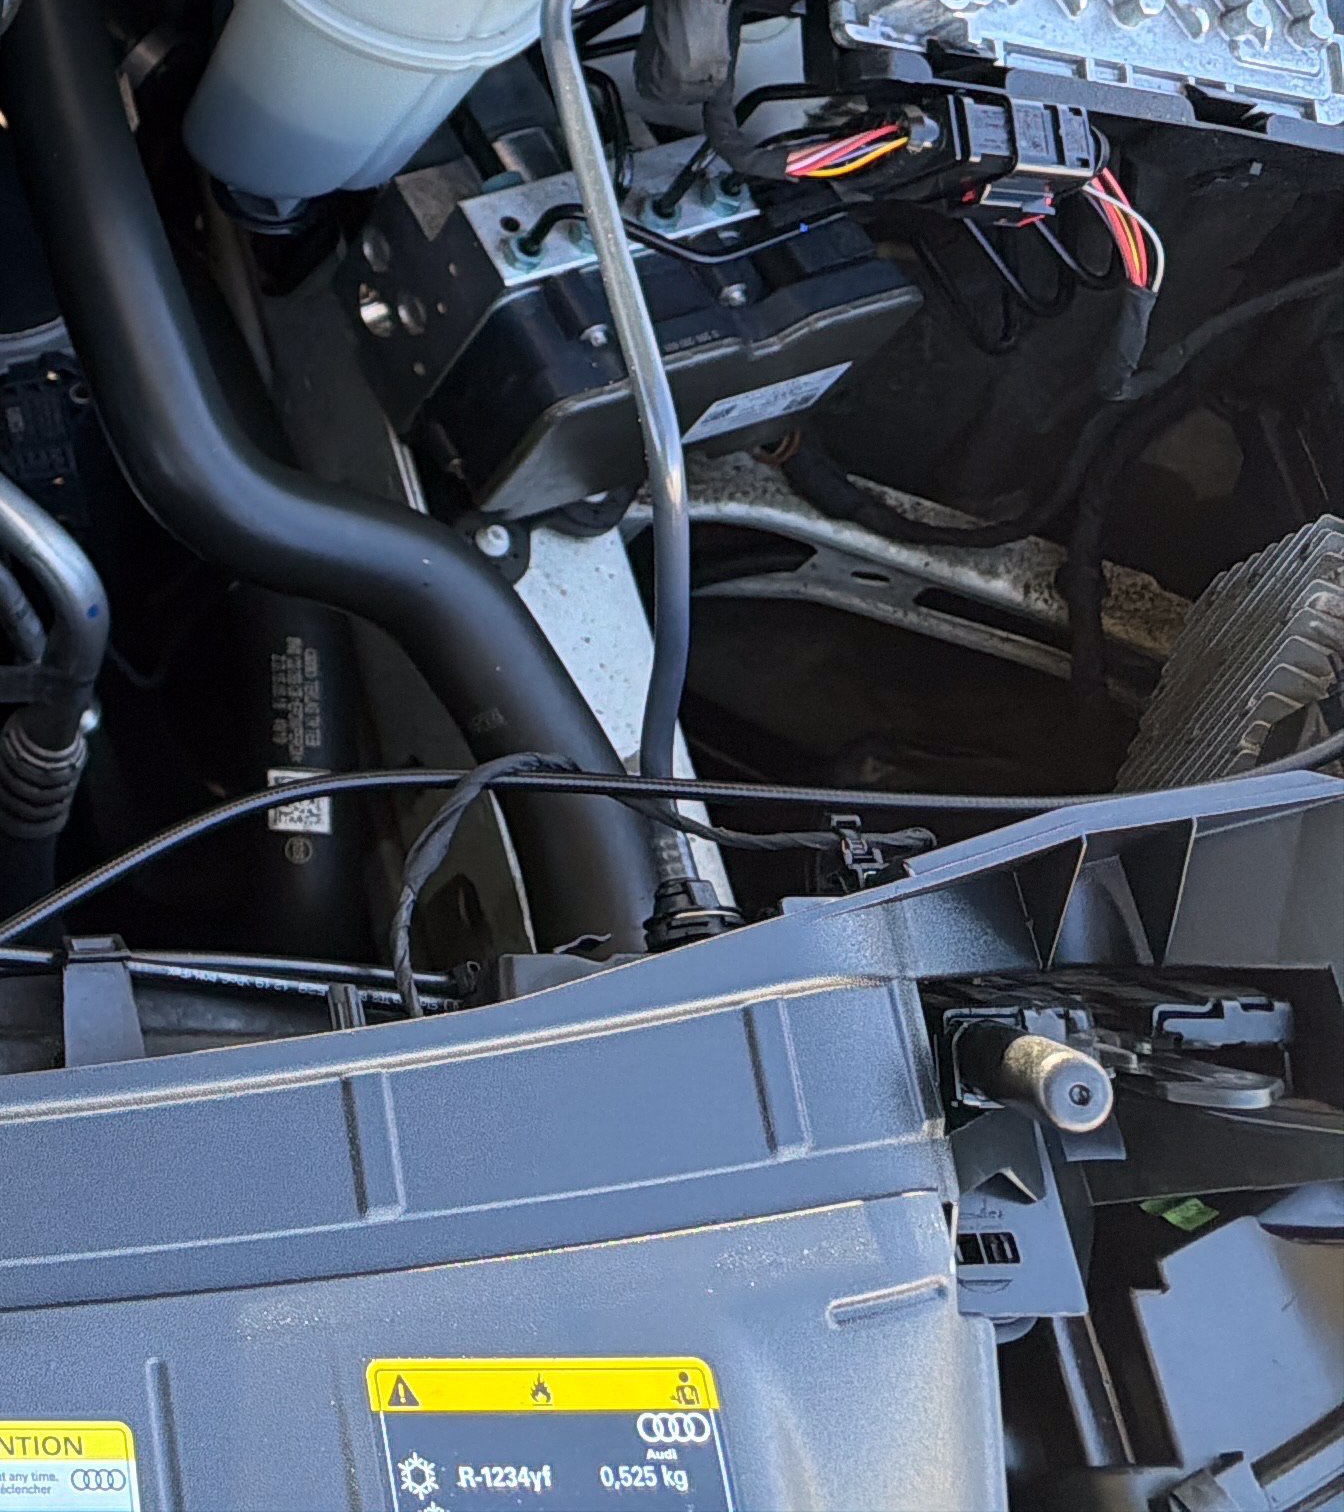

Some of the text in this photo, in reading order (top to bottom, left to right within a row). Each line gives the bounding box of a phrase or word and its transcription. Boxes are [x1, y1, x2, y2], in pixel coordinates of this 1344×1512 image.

[646, 1448, 678, 1461] Audi
[9, 1472, 29, 1484] any
[31, 1470, 59, 1482] time.
[457, 1466, 552, 1492] R-1234yf
[661, 1465, 689, 1491] kg
